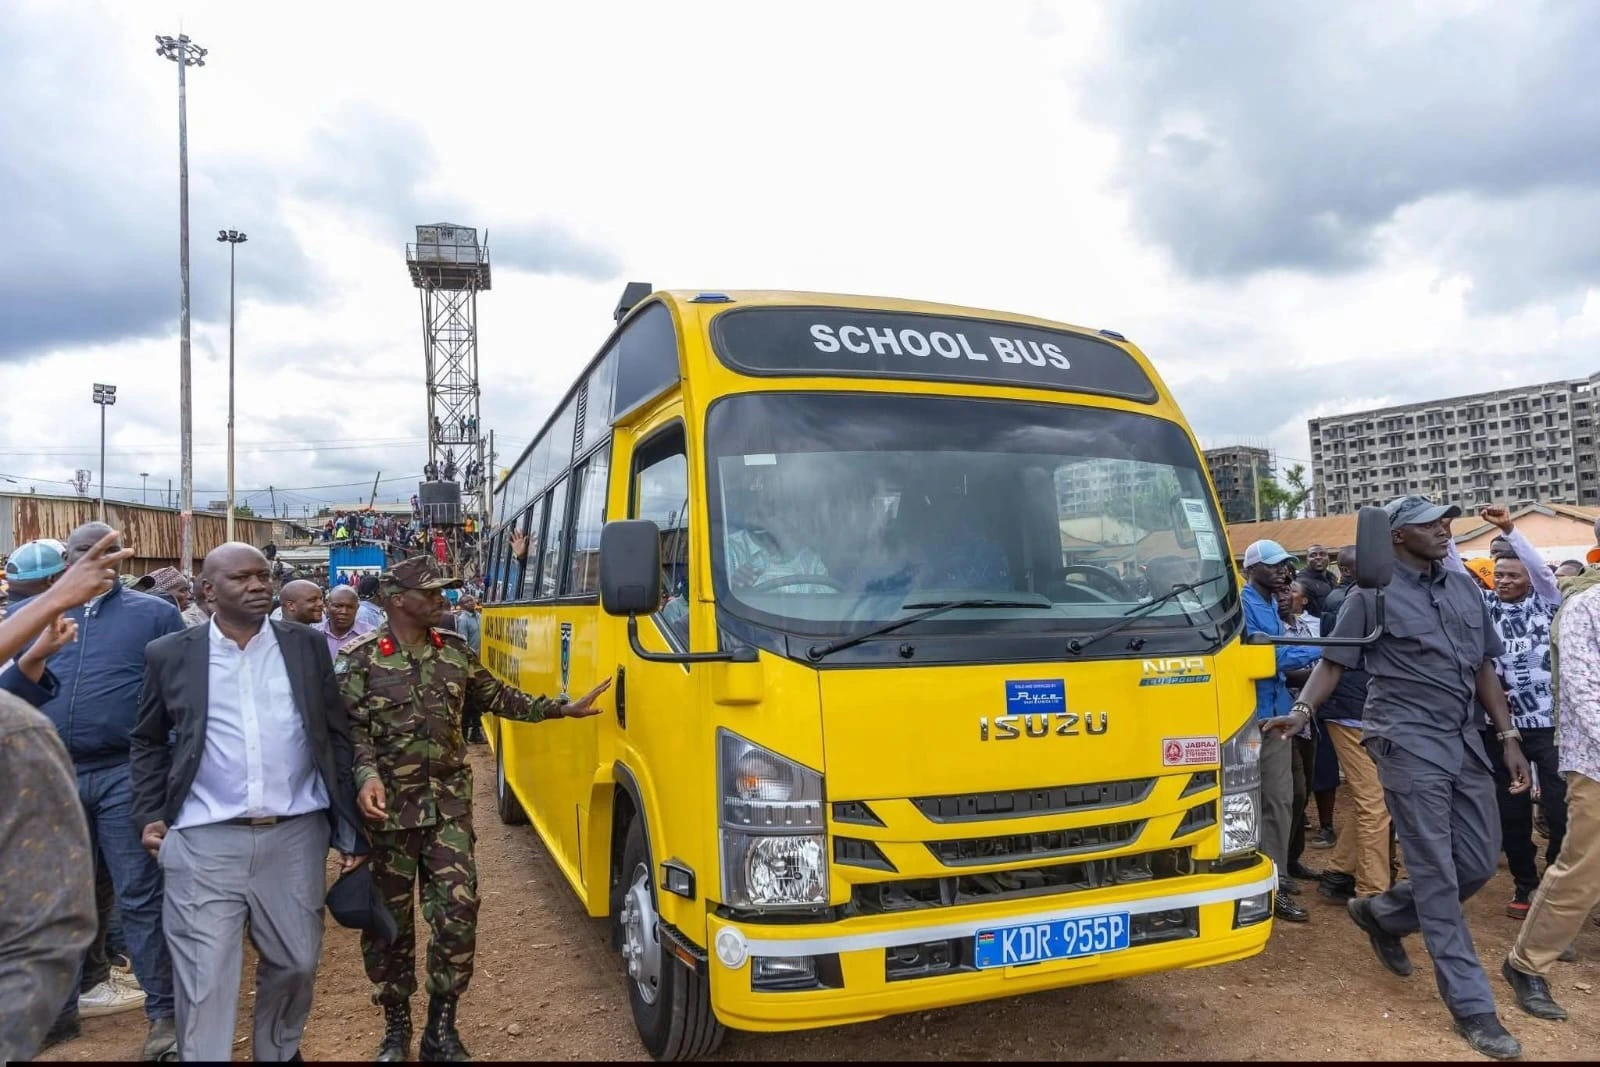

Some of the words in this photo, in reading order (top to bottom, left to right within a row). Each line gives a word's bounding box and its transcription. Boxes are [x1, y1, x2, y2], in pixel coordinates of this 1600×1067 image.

[809, 324, 988, 361] SCHOOL
[990, 337, 1071, 370] BUS
[1142, 656, 1205, 674] NQR
[980, 712, 1107, 741] ISUZU
[1002, 925, 1053, 963] KDR
[1063, 915, 1124, 954] 955P
